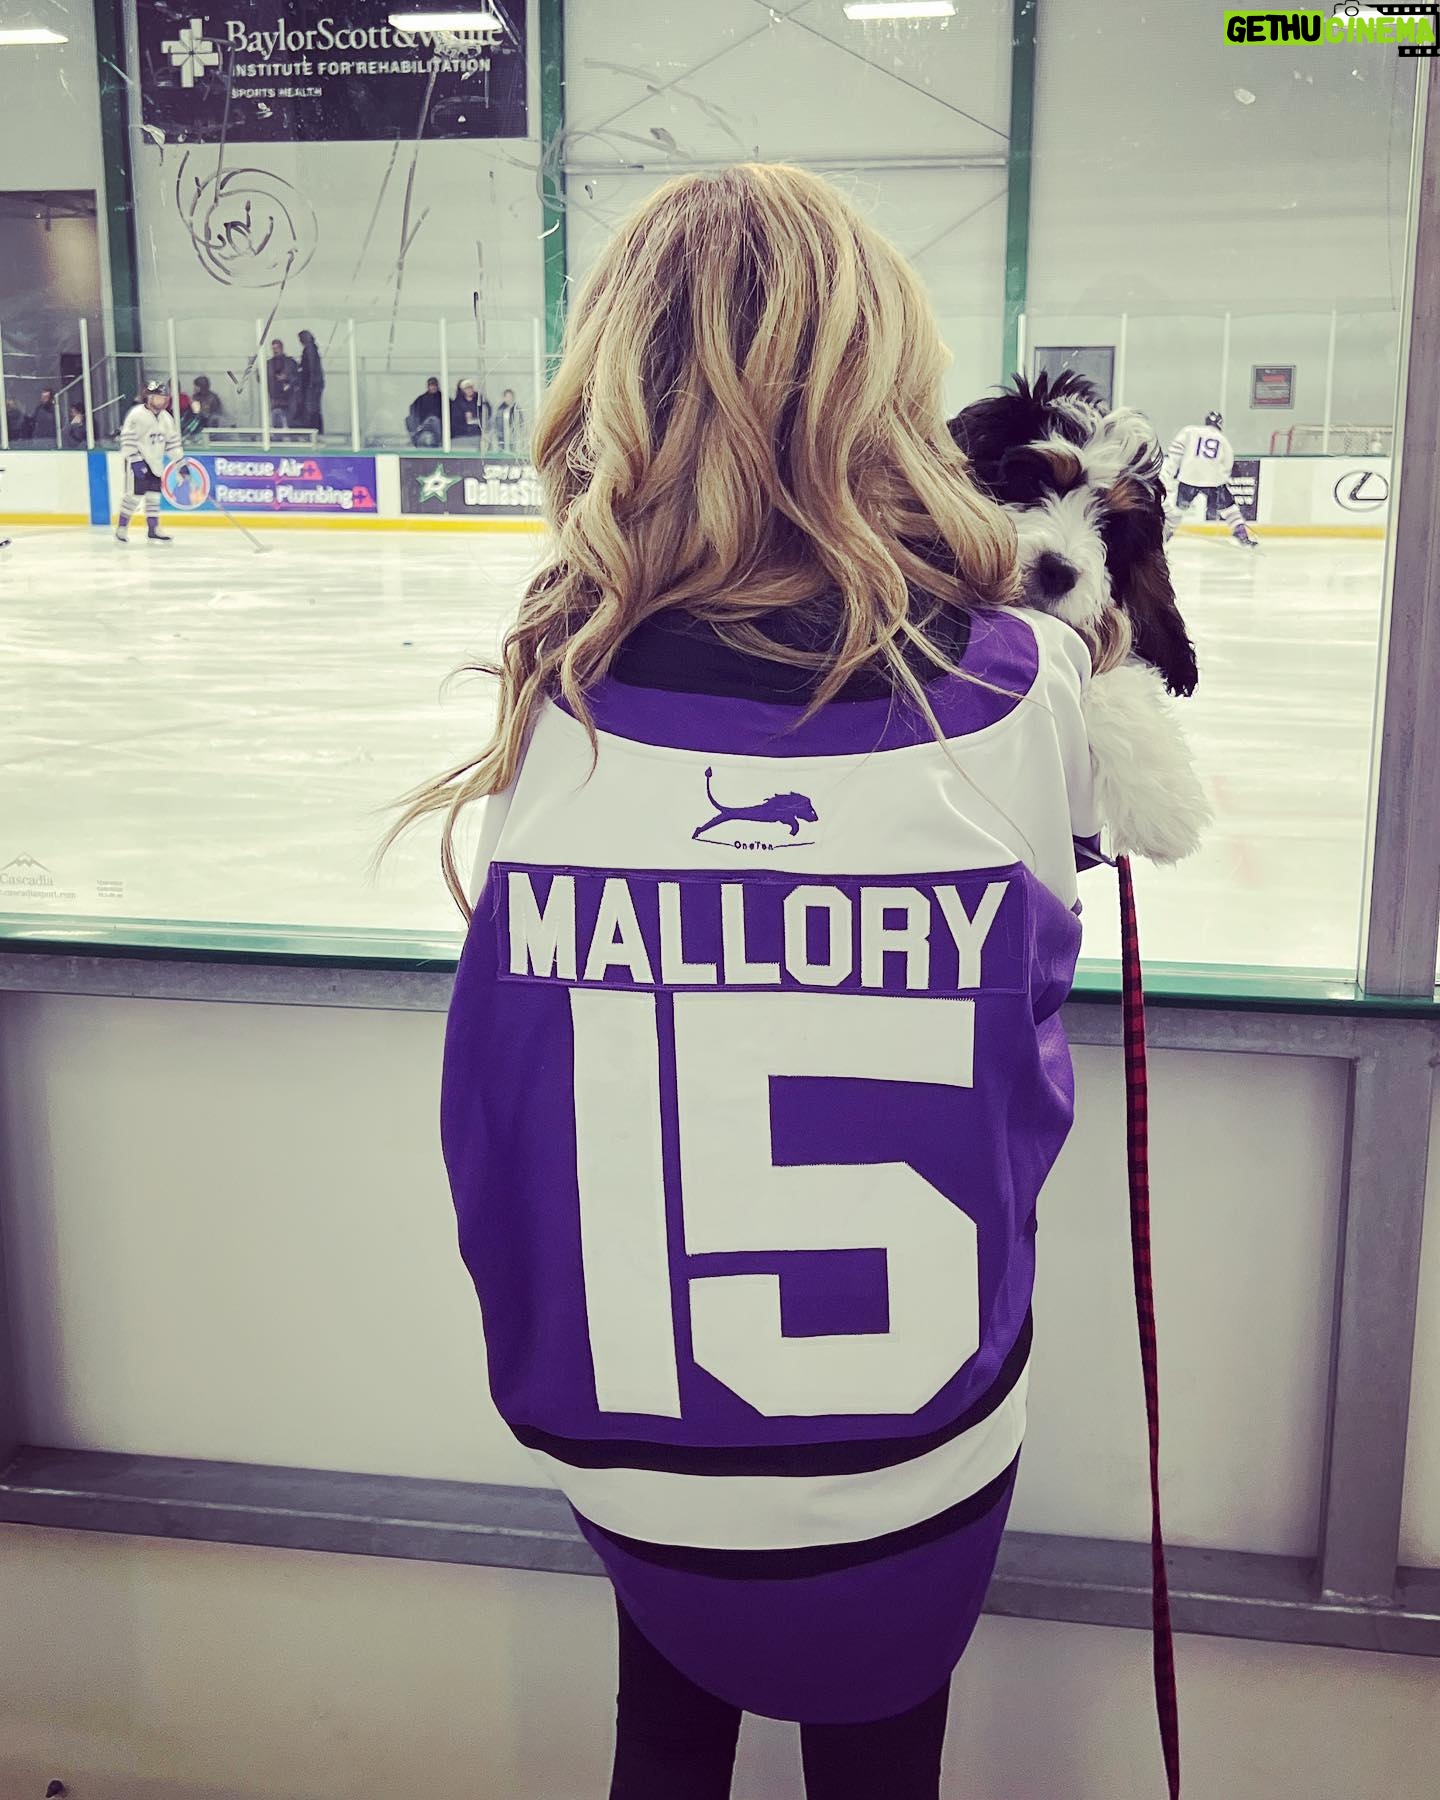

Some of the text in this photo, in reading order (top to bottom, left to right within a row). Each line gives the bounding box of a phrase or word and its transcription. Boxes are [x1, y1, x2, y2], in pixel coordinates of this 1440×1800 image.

[232, 58, 491, 77] INSTITUTE FOR REHABILITATION
[231, 87, 276, 98] SPORTS
[1196, 437, 1220, 459] 19
[214, 458, 304, 477] Rescue Air
[214, 485, 354, 510] Rescue Plumbing
[734, 840, 774, 851] OneTen
[508, 871, 1011, 990] MALLORY
[568, 987, 980, 1420] 15
